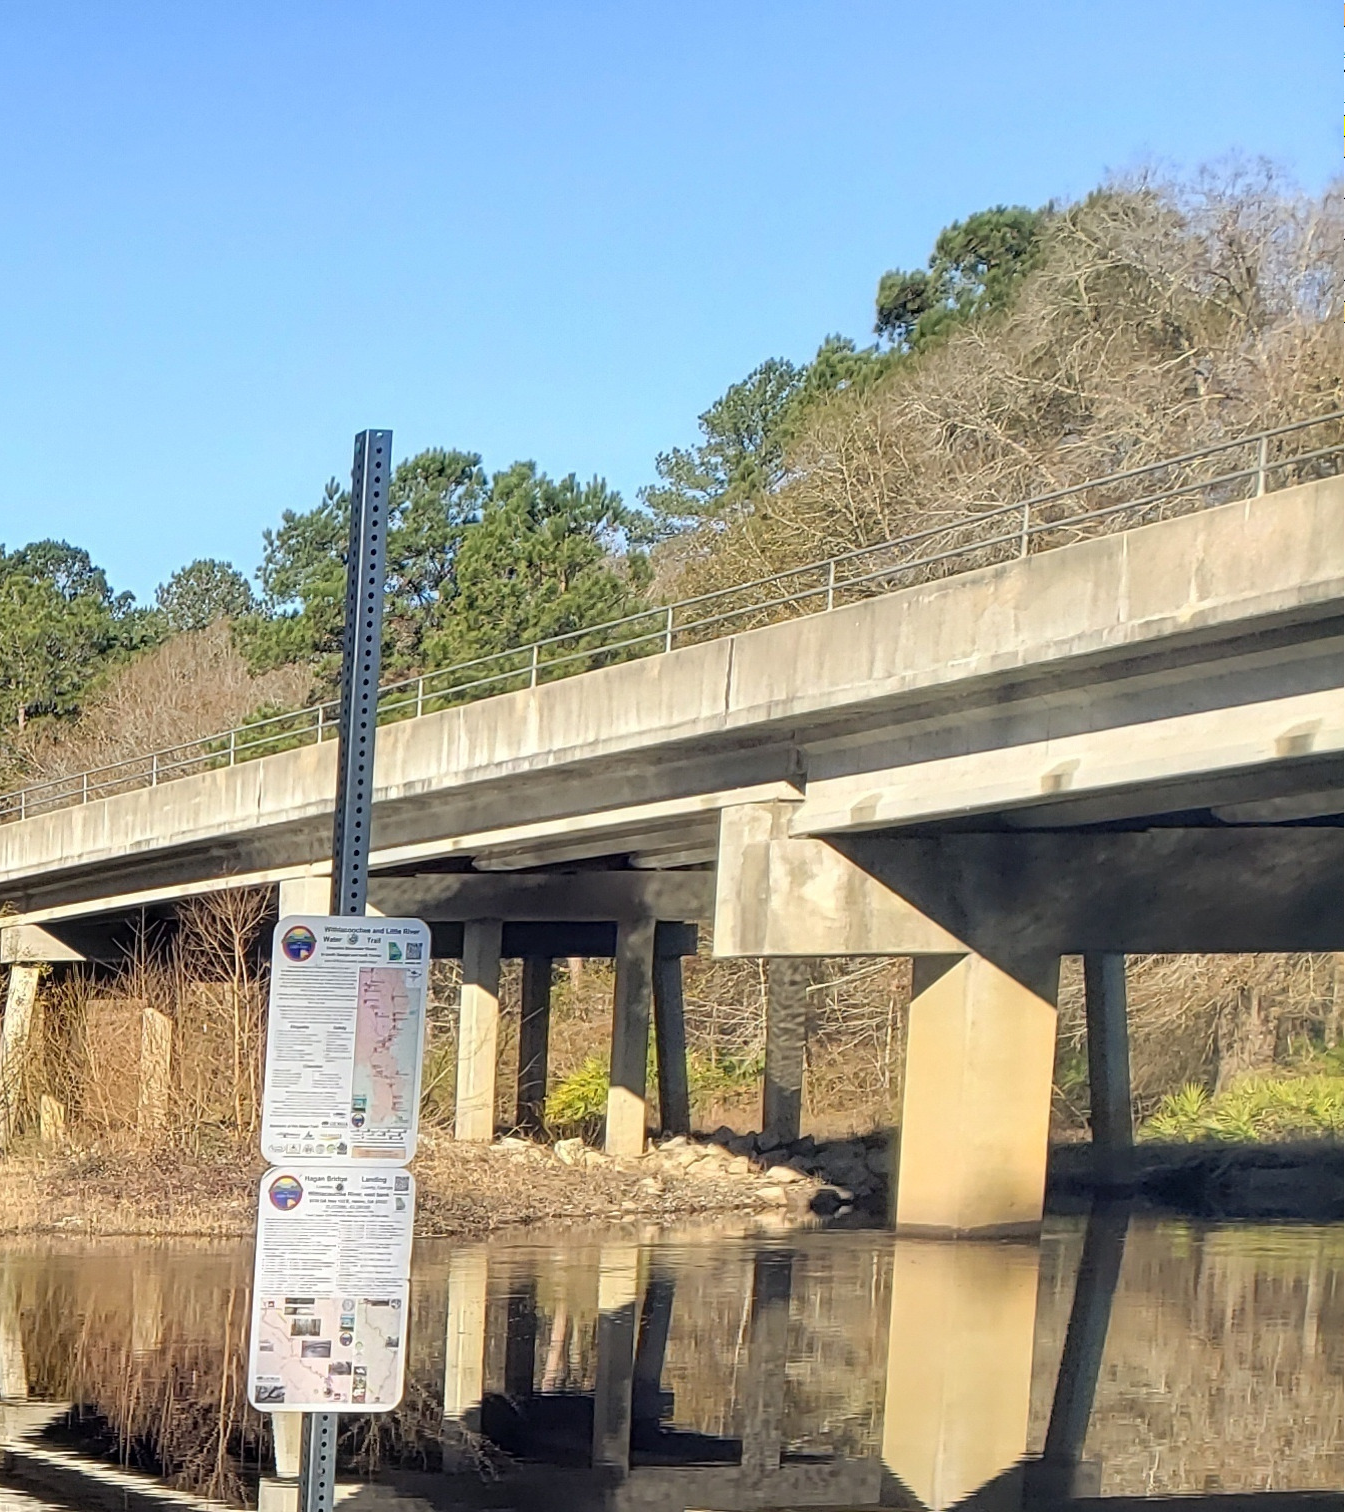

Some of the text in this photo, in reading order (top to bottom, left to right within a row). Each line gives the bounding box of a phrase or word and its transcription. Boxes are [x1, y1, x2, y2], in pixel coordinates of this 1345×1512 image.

[386, 927, 402, 935] Little
[304, 1175, 387, 1184] Hagan Bridge Landing
